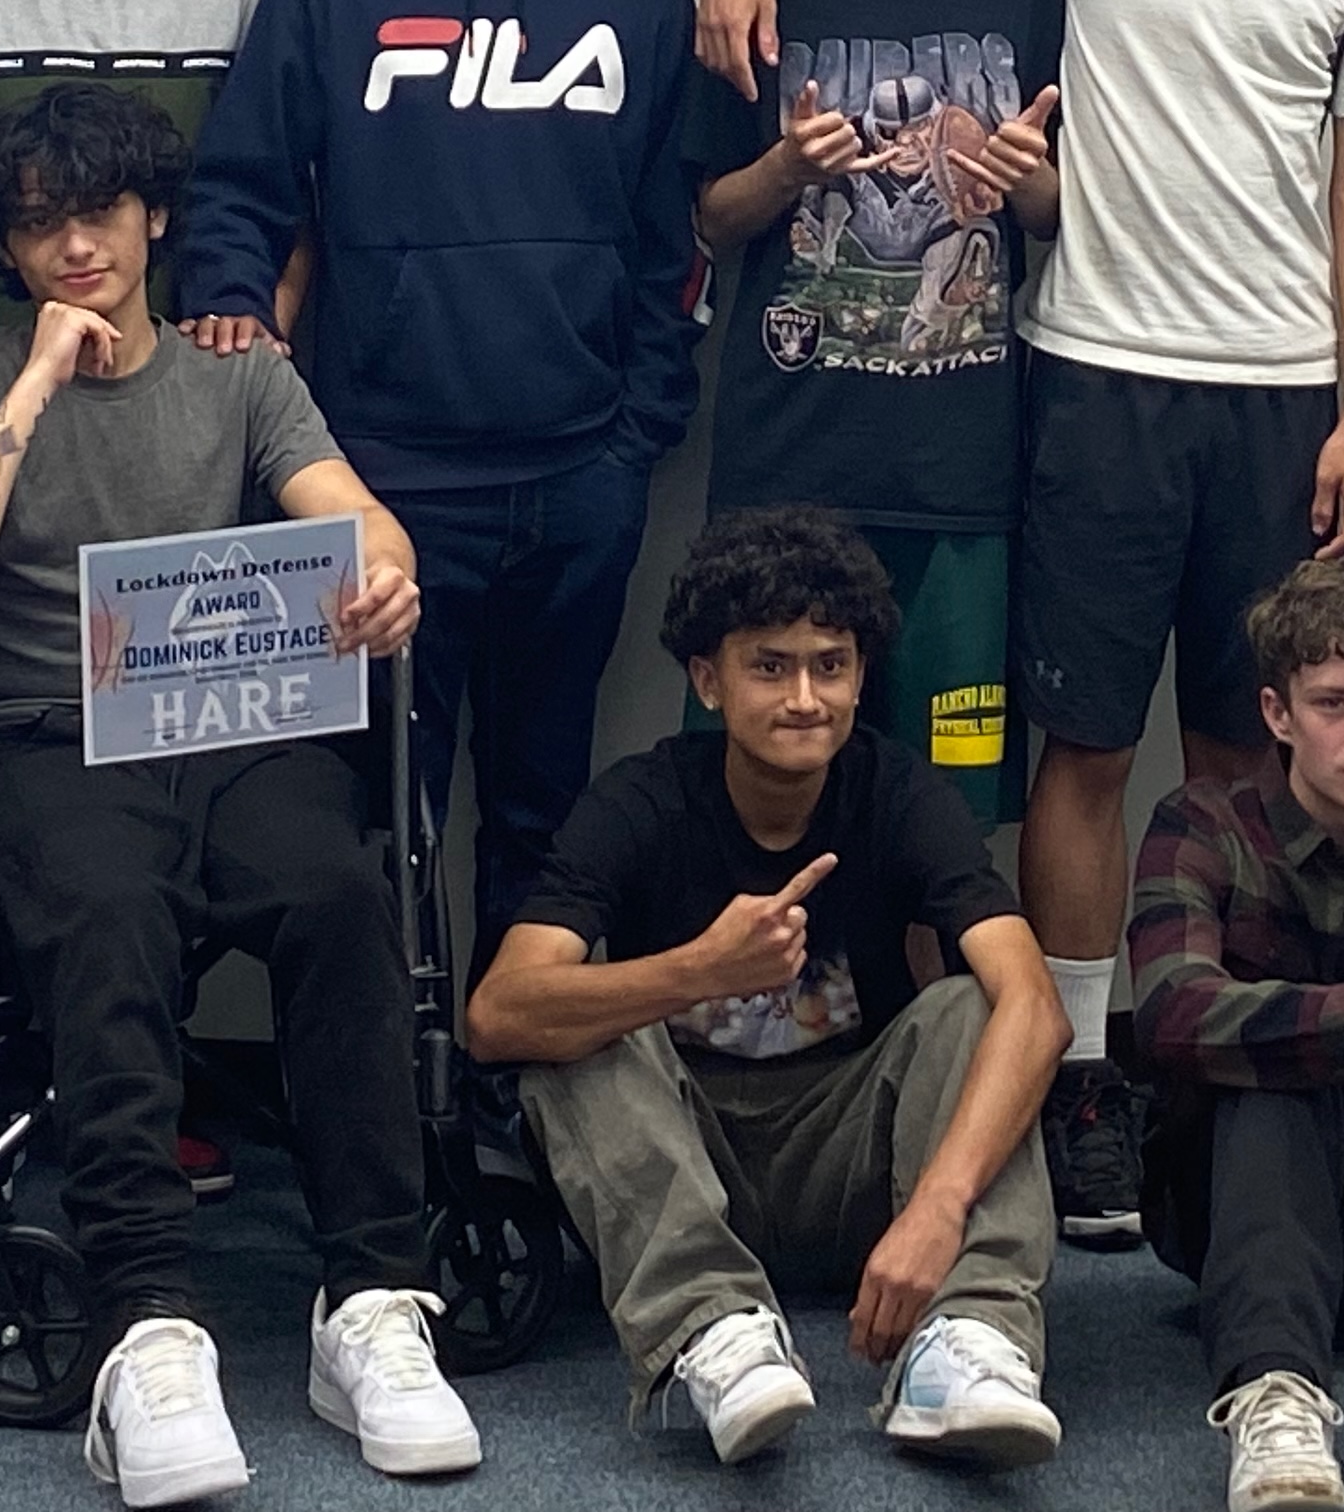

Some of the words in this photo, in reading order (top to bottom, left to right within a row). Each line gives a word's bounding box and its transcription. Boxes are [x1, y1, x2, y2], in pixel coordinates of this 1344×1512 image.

[363, 16, 626, 115] FILA
[823, 353, 906, 377] SACK
[116, 567, 236, 594] Lockdown
[241, 555, 333, 579] Defense
[191, 590, 261, 618] AWARD
[124, 638, 228, 670] DOMINICK
[235, 623, 332, 657] EUSTACE
[151, 672, 312, 748] HARE
